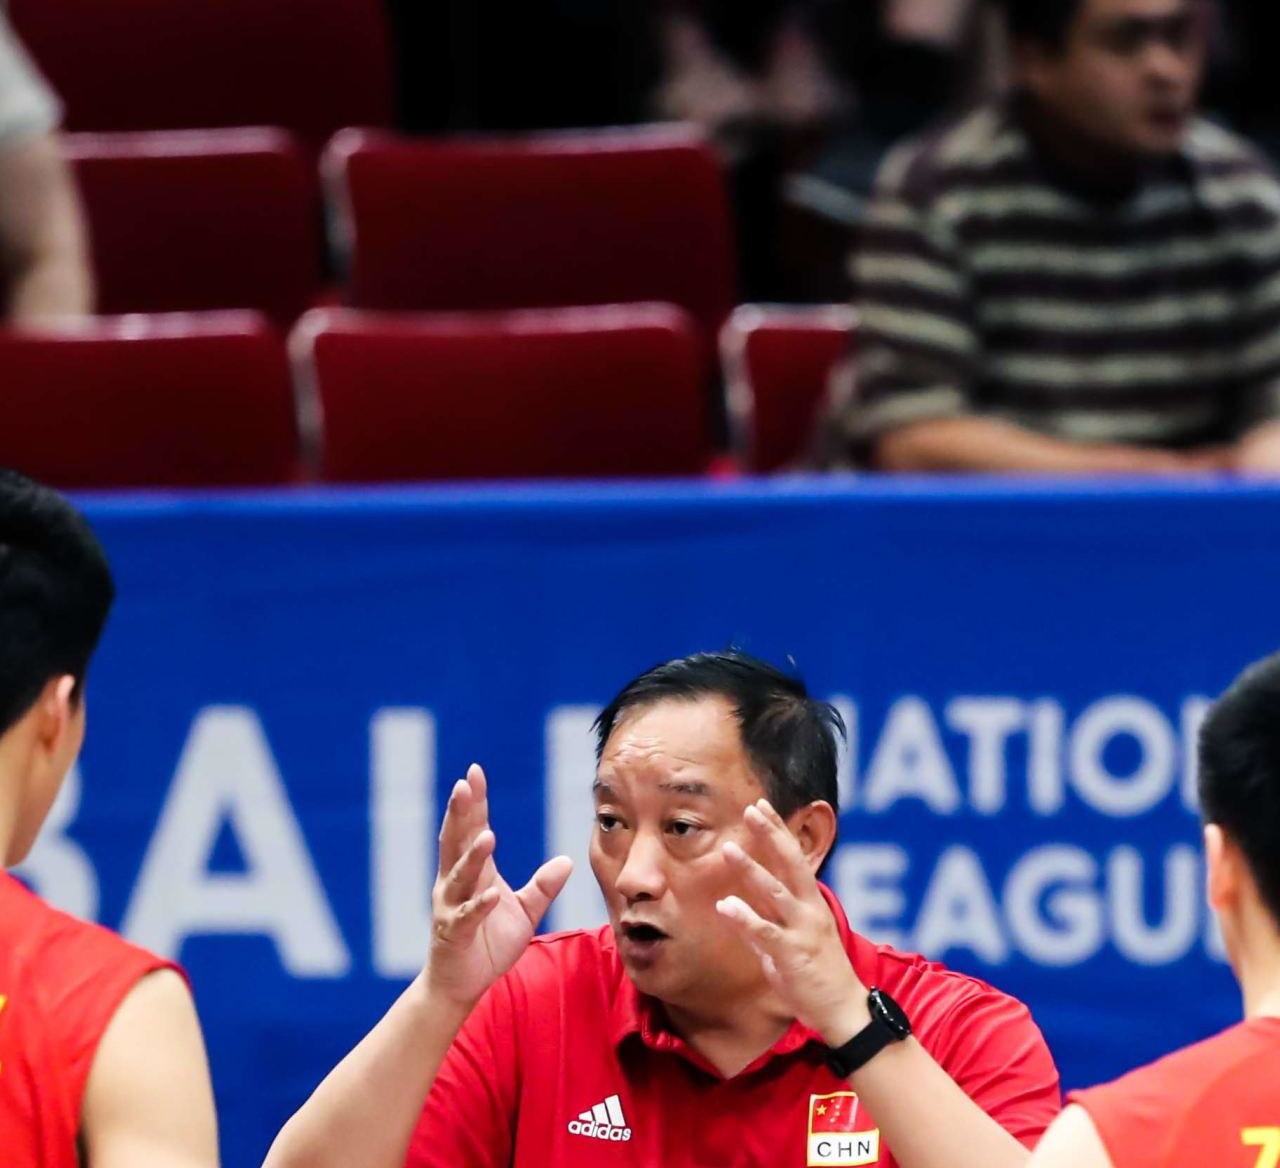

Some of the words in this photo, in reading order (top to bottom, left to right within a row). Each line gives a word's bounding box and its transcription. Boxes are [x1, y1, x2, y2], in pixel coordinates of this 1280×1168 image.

[832, 694, 1218, 817] ATIO
[832, 842, 1235, 966] EAGU
[567, 1118, 632, 1142] adidas
[816, 1139, 871, 1158] CHN
